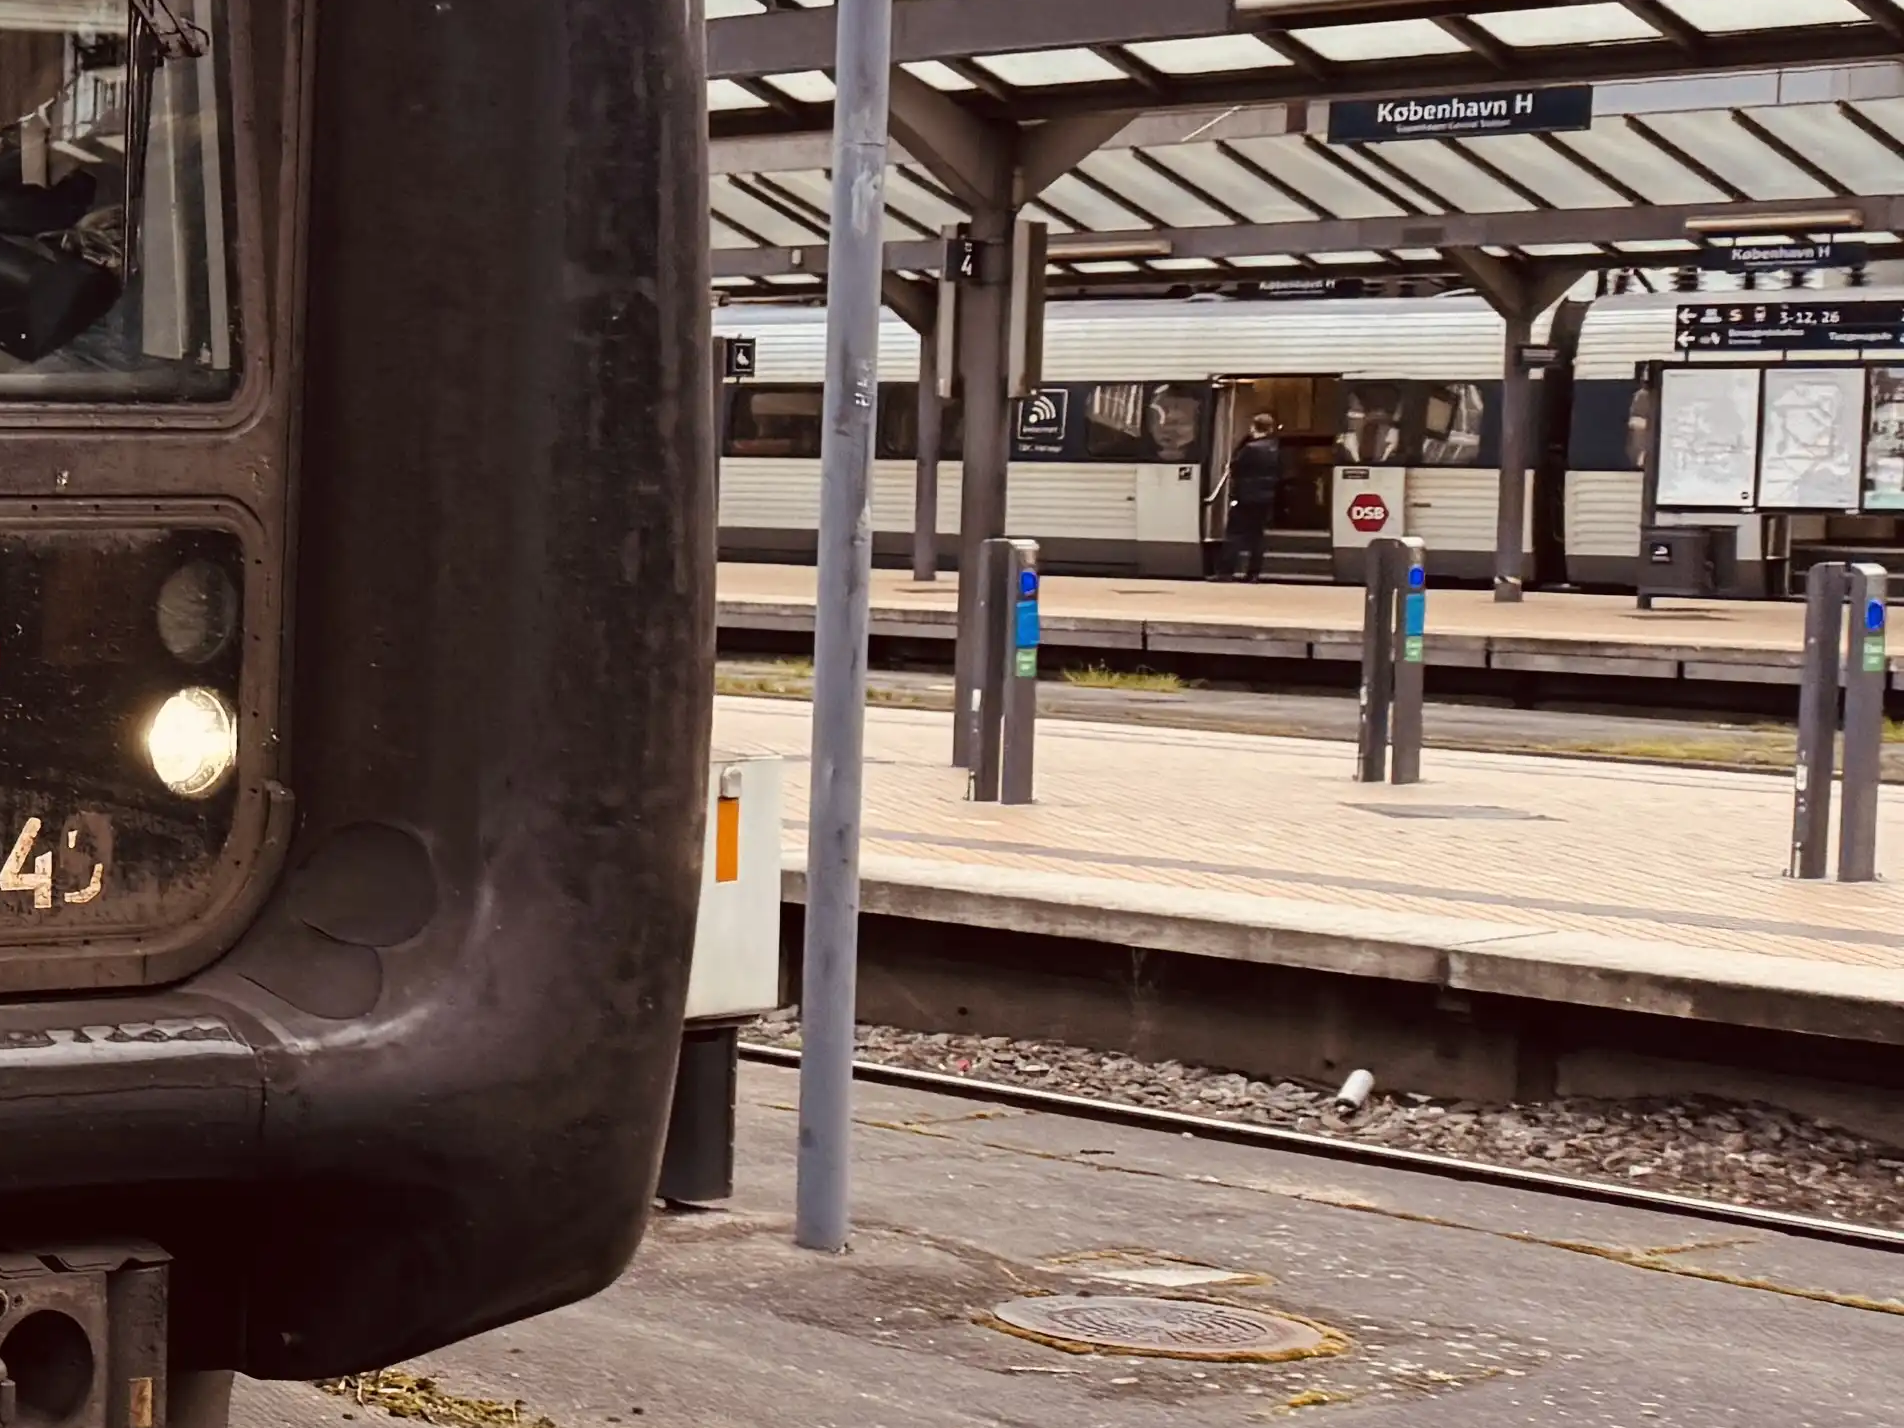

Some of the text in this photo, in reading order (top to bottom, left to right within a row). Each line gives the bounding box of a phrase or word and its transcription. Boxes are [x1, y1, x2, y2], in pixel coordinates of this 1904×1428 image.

[1377, 92, 1534, 123] København H
[1817, 245, 1831, 258] H
[960, 254, 973, 276] 4
[1352, 506, 1385, 520] DSB
